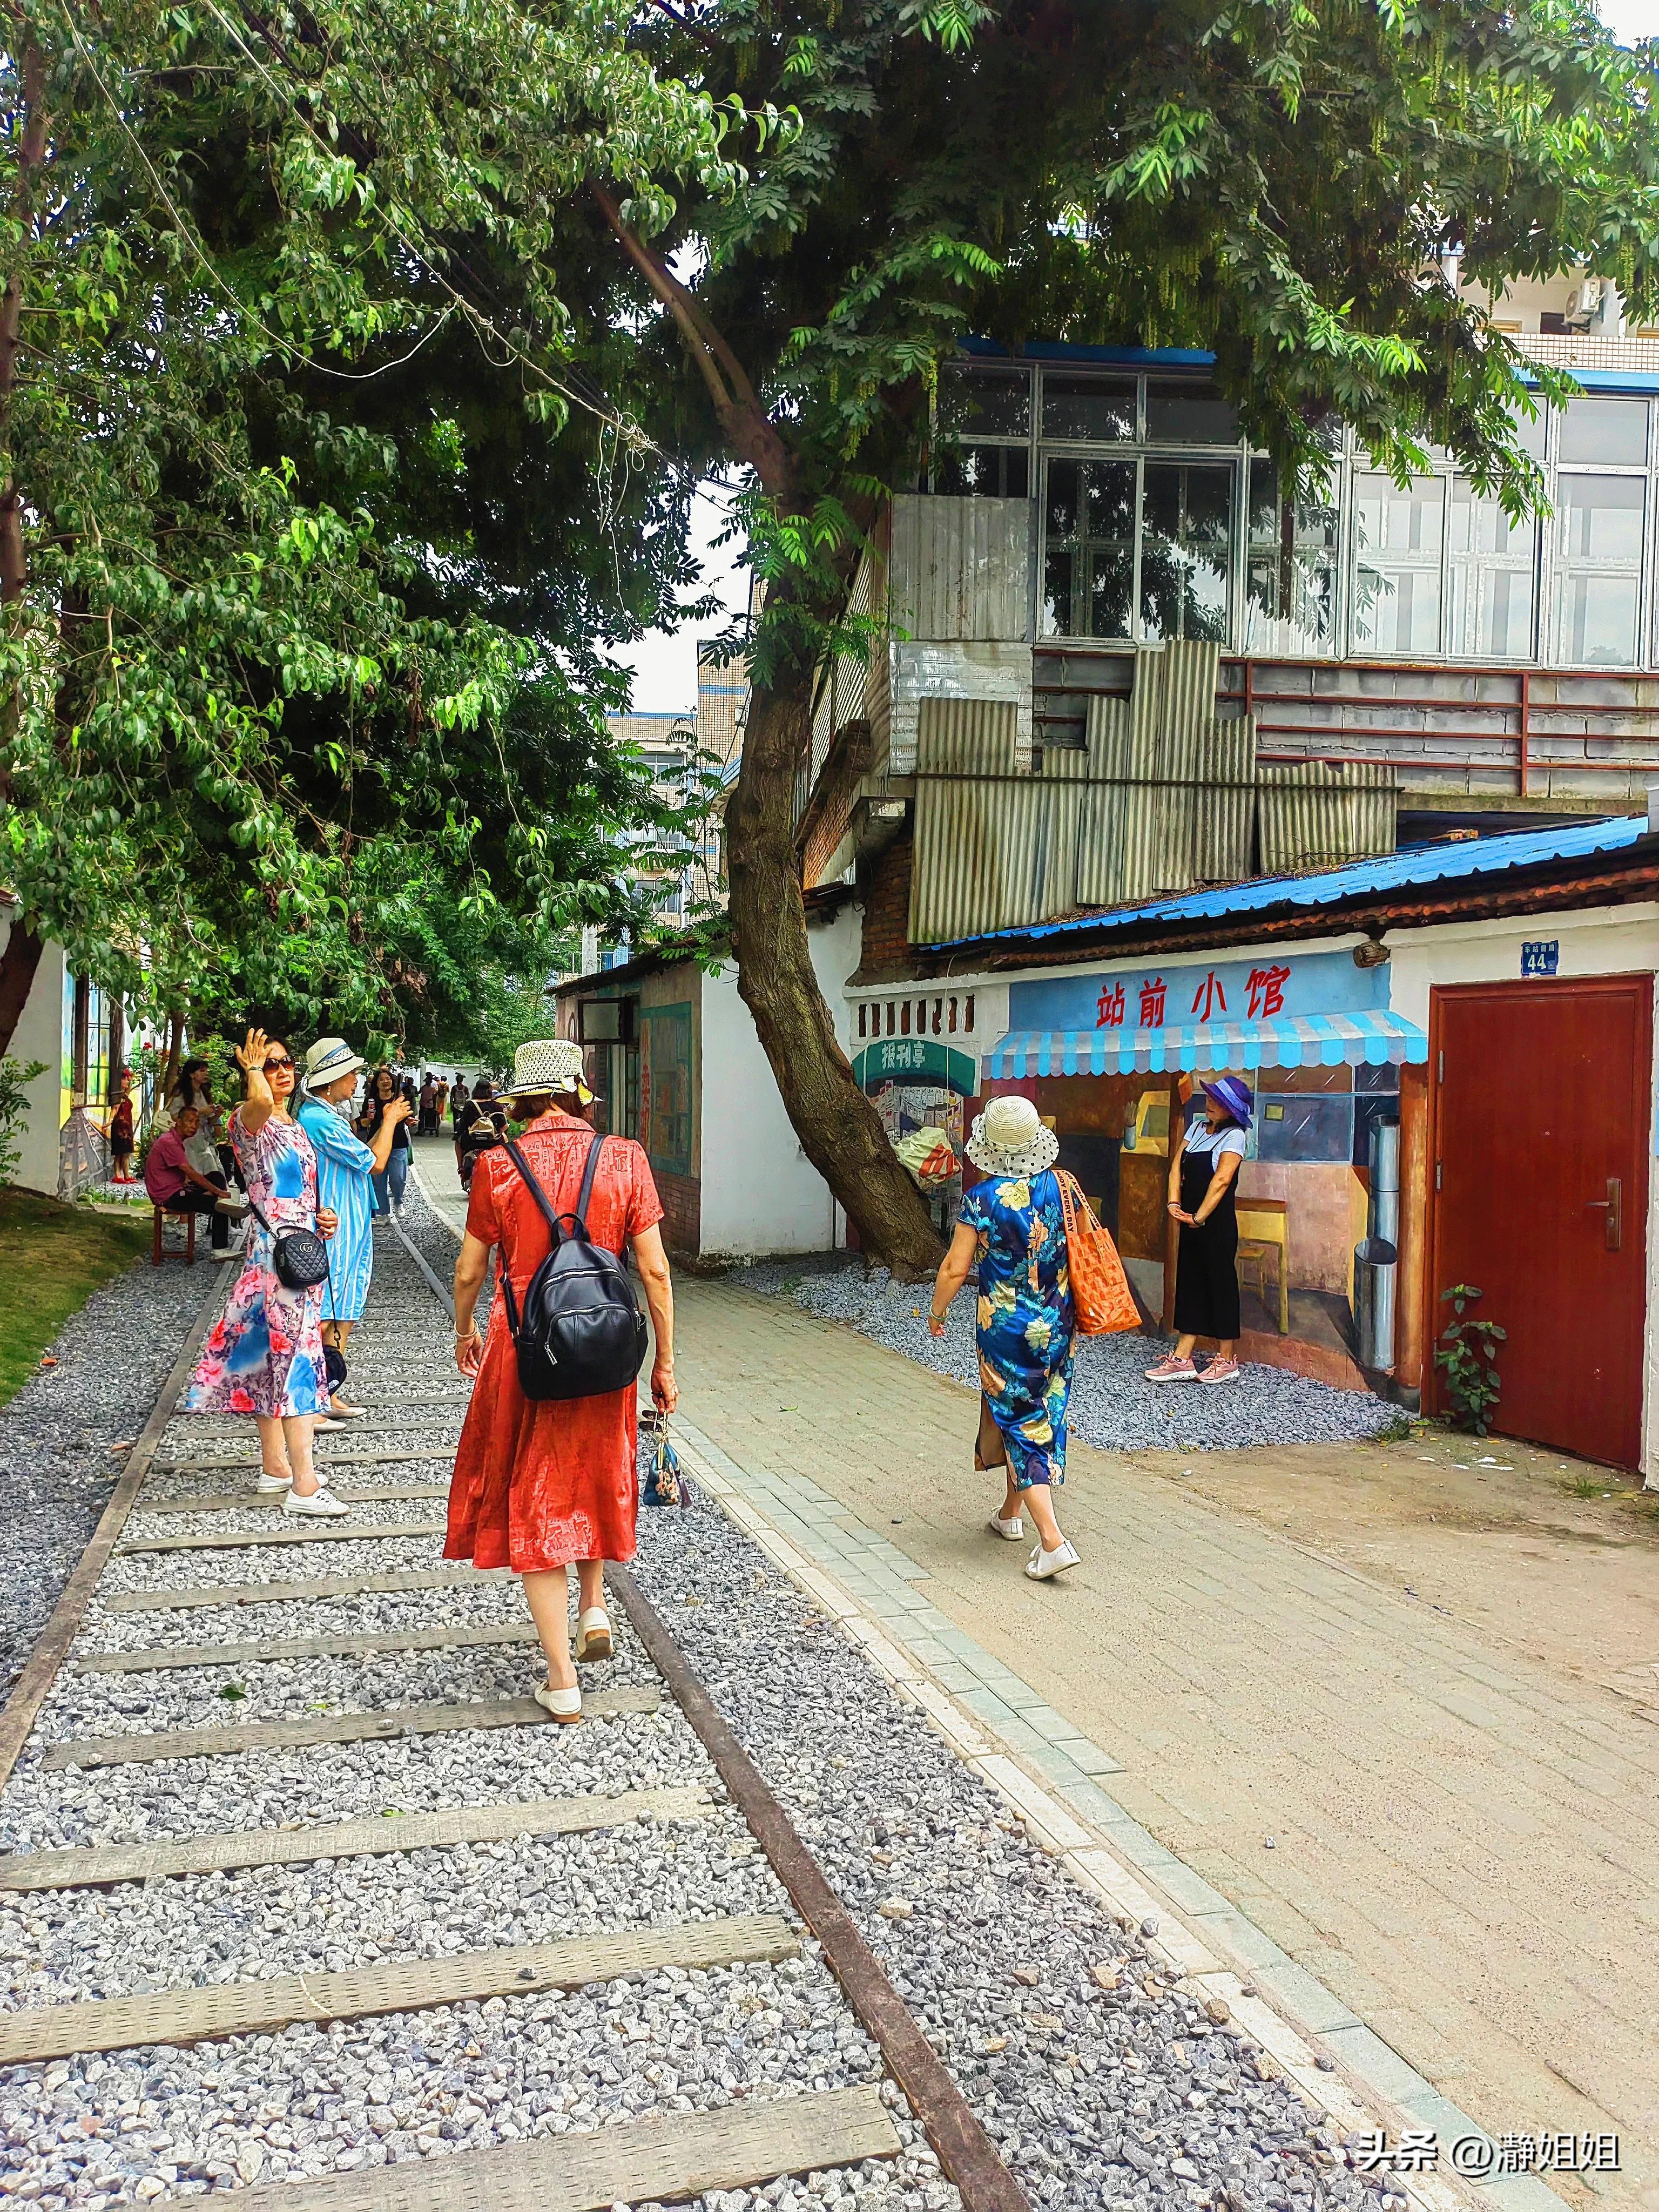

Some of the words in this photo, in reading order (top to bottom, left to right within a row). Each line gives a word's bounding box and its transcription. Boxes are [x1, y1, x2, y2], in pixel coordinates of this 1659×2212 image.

[1527, 954, 1547, 970] 44
[1096, 965, 1291, 1028] 站前小馆
[882, 1041, 925, 1069] 报刊亭
[1062, 1190, 1071, 1215] EVERY
